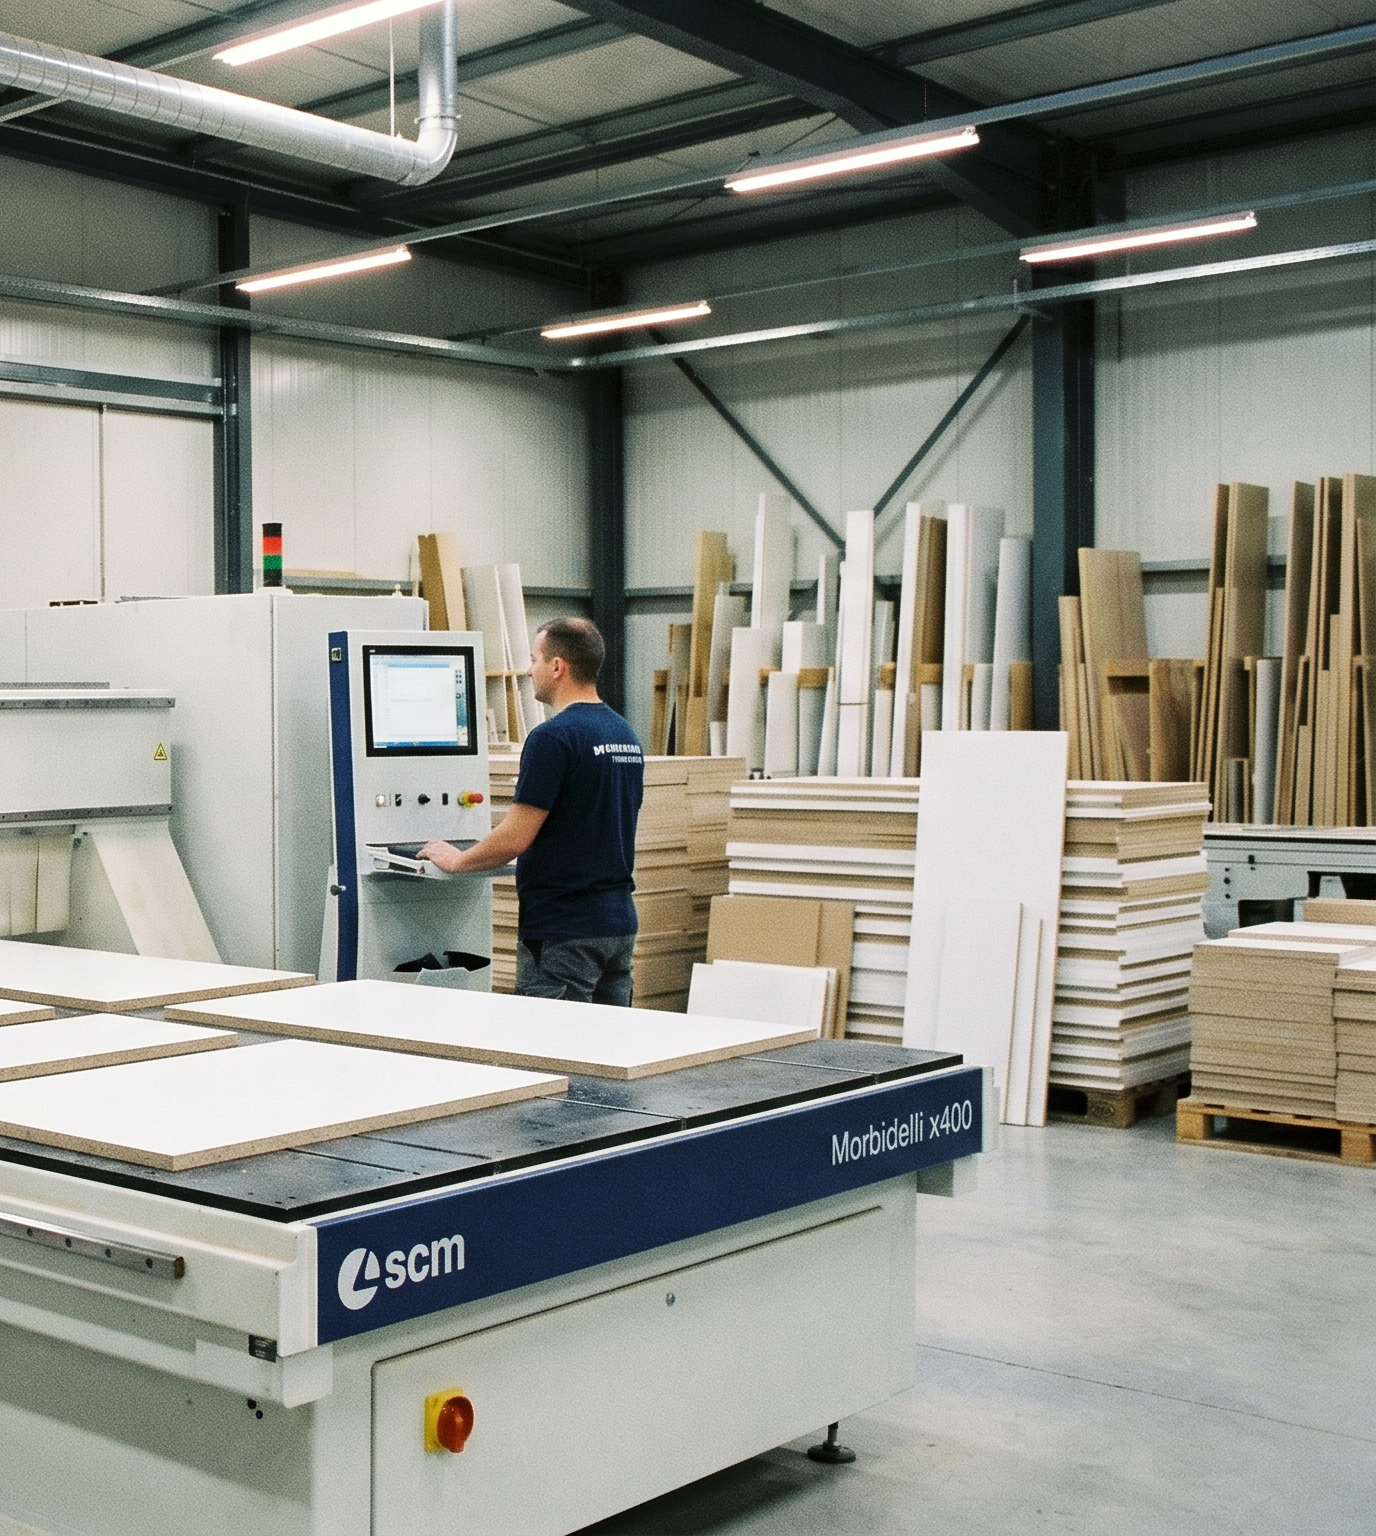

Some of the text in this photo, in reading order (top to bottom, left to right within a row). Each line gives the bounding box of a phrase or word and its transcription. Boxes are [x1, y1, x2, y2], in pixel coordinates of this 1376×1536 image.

[831, 1099, 973, 1166] Morbidelli x400
[384, 1233, 465, 1290] scm
